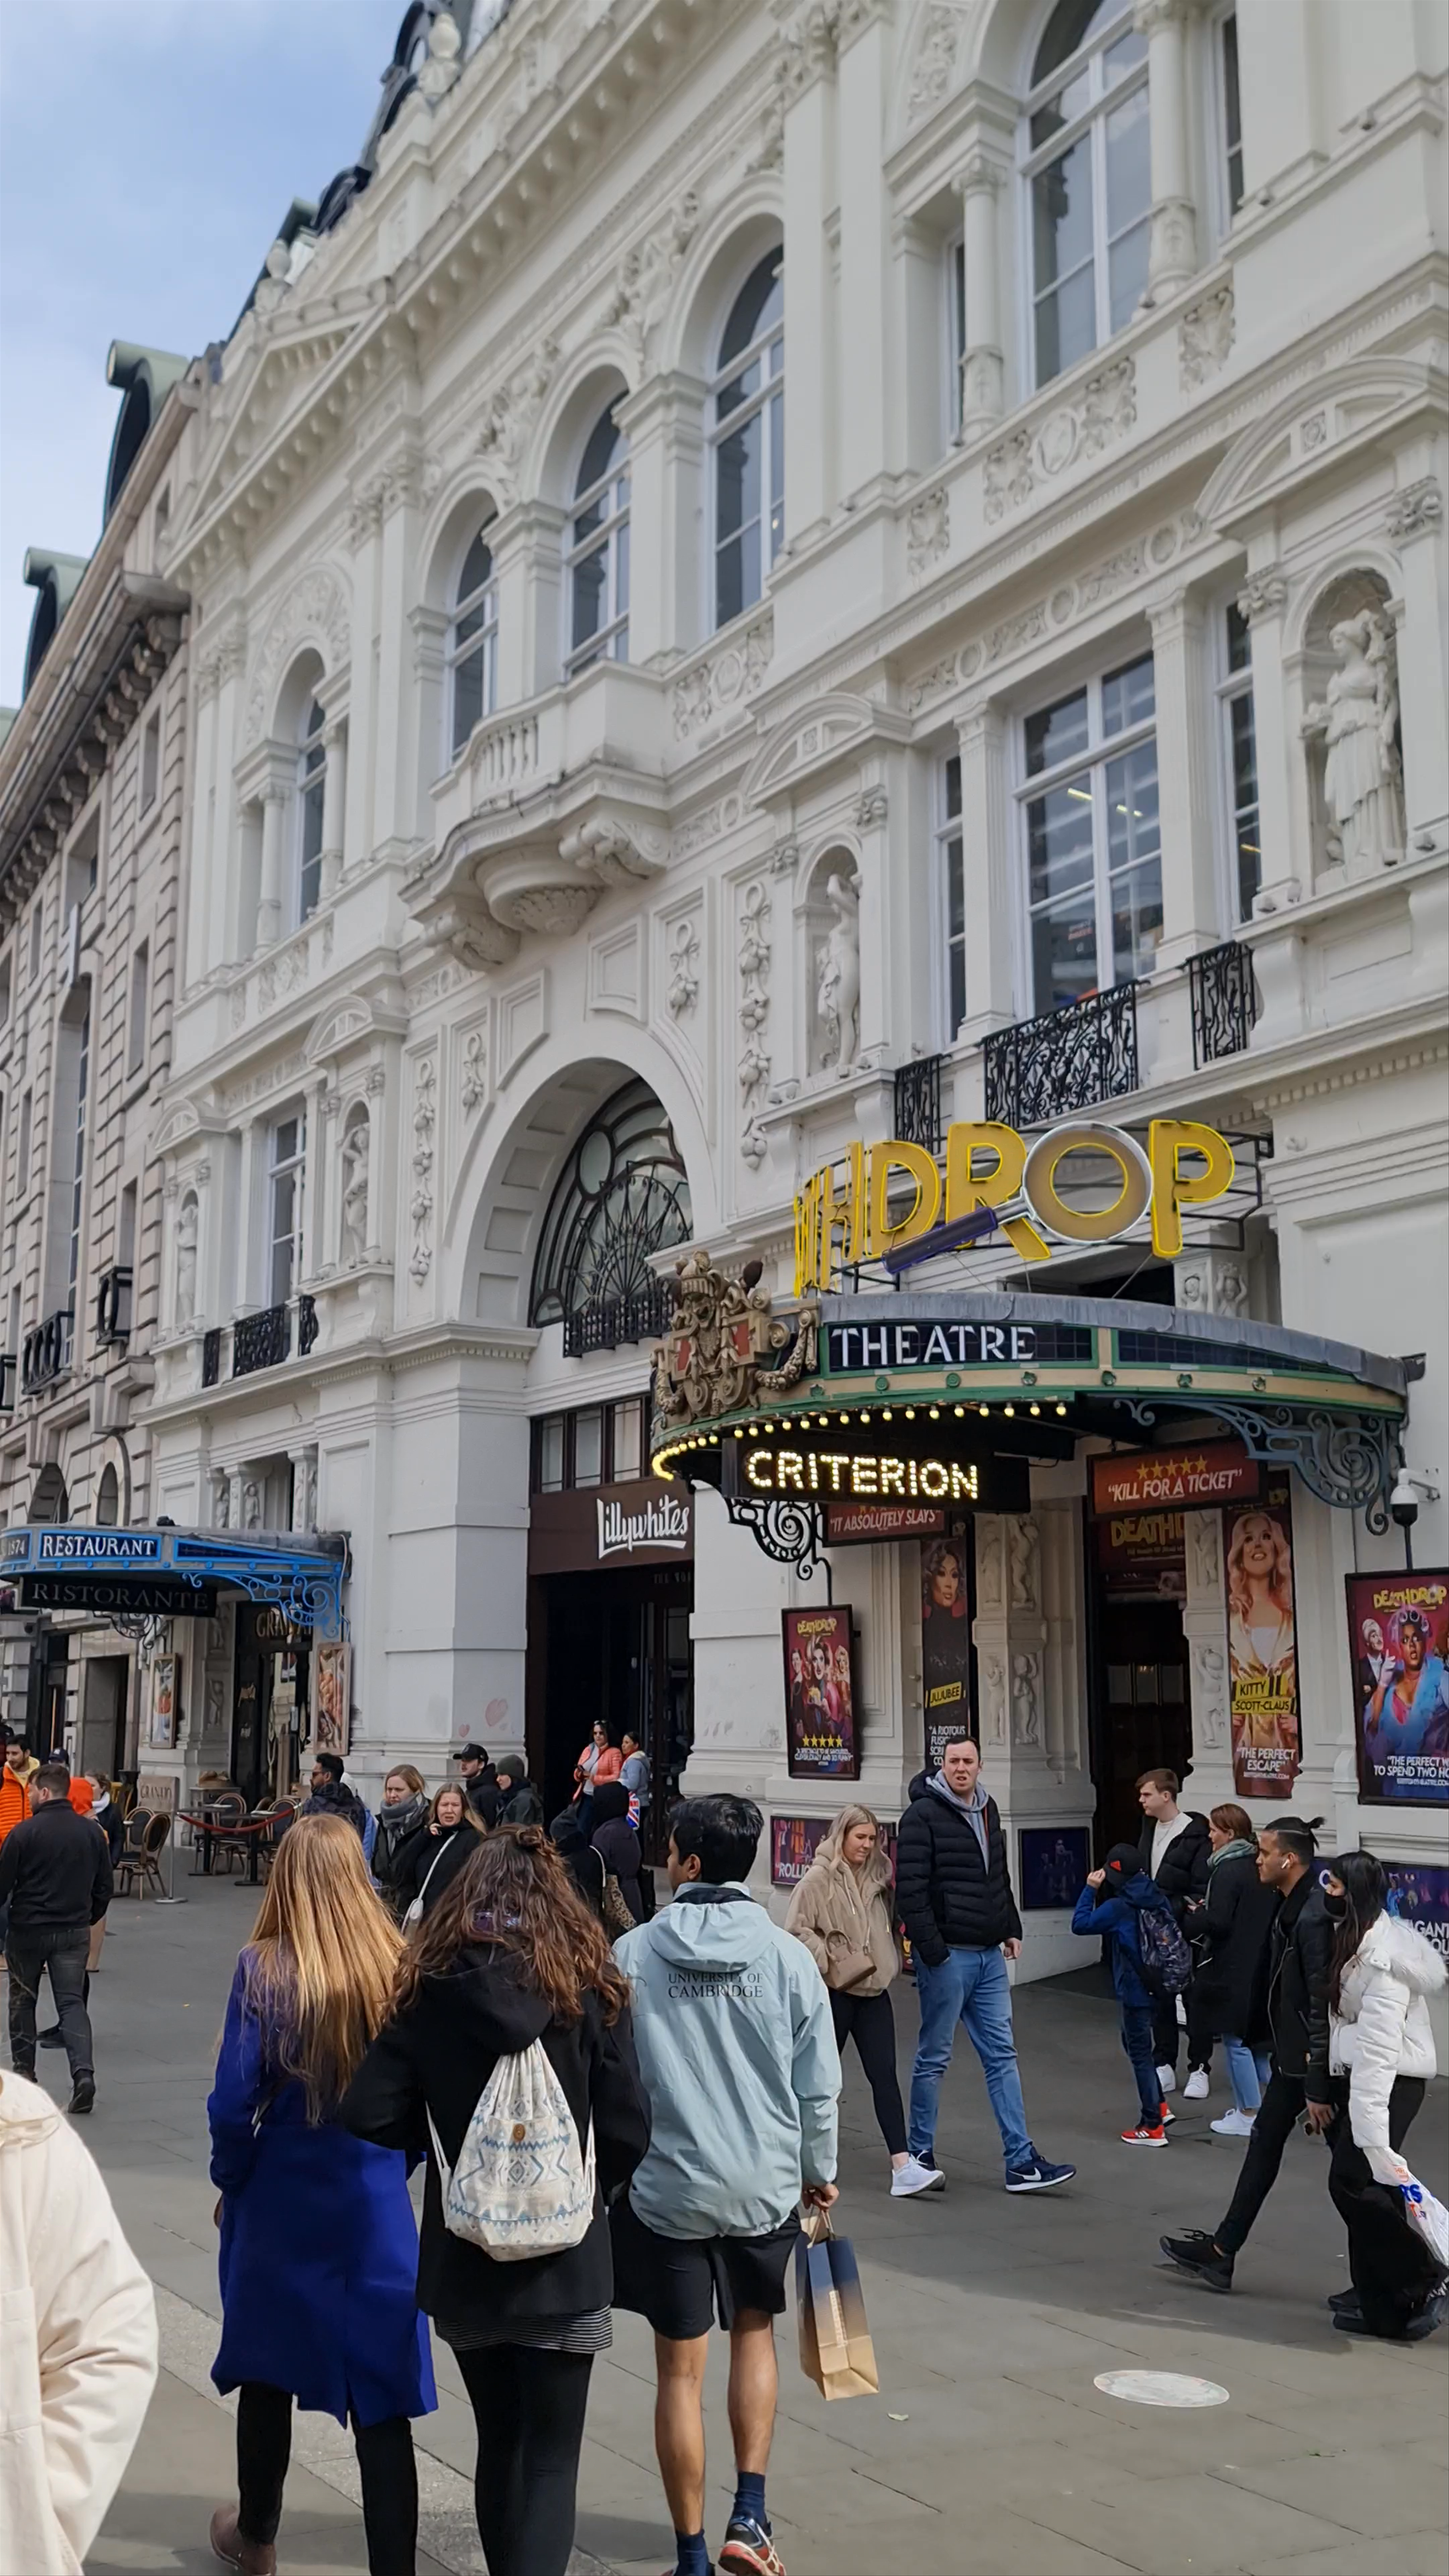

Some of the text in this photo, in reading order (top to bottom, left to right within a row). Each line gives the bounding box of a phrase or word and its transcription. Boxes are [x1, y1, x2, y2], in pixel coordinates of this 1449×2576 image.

[832, 1325, 1036, 1367] THEATRE
[747, 1450, 978, 1499] CRITERION
[1143, 1478, 1170, 1498] FOR
[1173, 1477, 1184, 1495] A
[597, 1494, 689, 1559] Lillywhites
[844, 1510, 904, 1532] ABSOLUTELY
[43, 1535, 154, 1557] RESTAURANT
[32, 1584, 208, 1610] RISTORANTE
[1240, 1679, 1266, 1696] KITTY
[1235, 1701, 1289, 1711] SCOTT-CLAUS
[1258, 1749, 1296, 1761] PERFECT
[1406, 1756, 1440, 1767] PERFECT
[1374, 1765, 1386, 1776] TO
[1387, 1766, 1415, 1777] SPEND
[1417, 1767, 1437, 1778] TWO
[668, 1973, 763, 1984] UNIVERSITY OF
[668, 1985, 763, 1998] CAMBRIDGE
